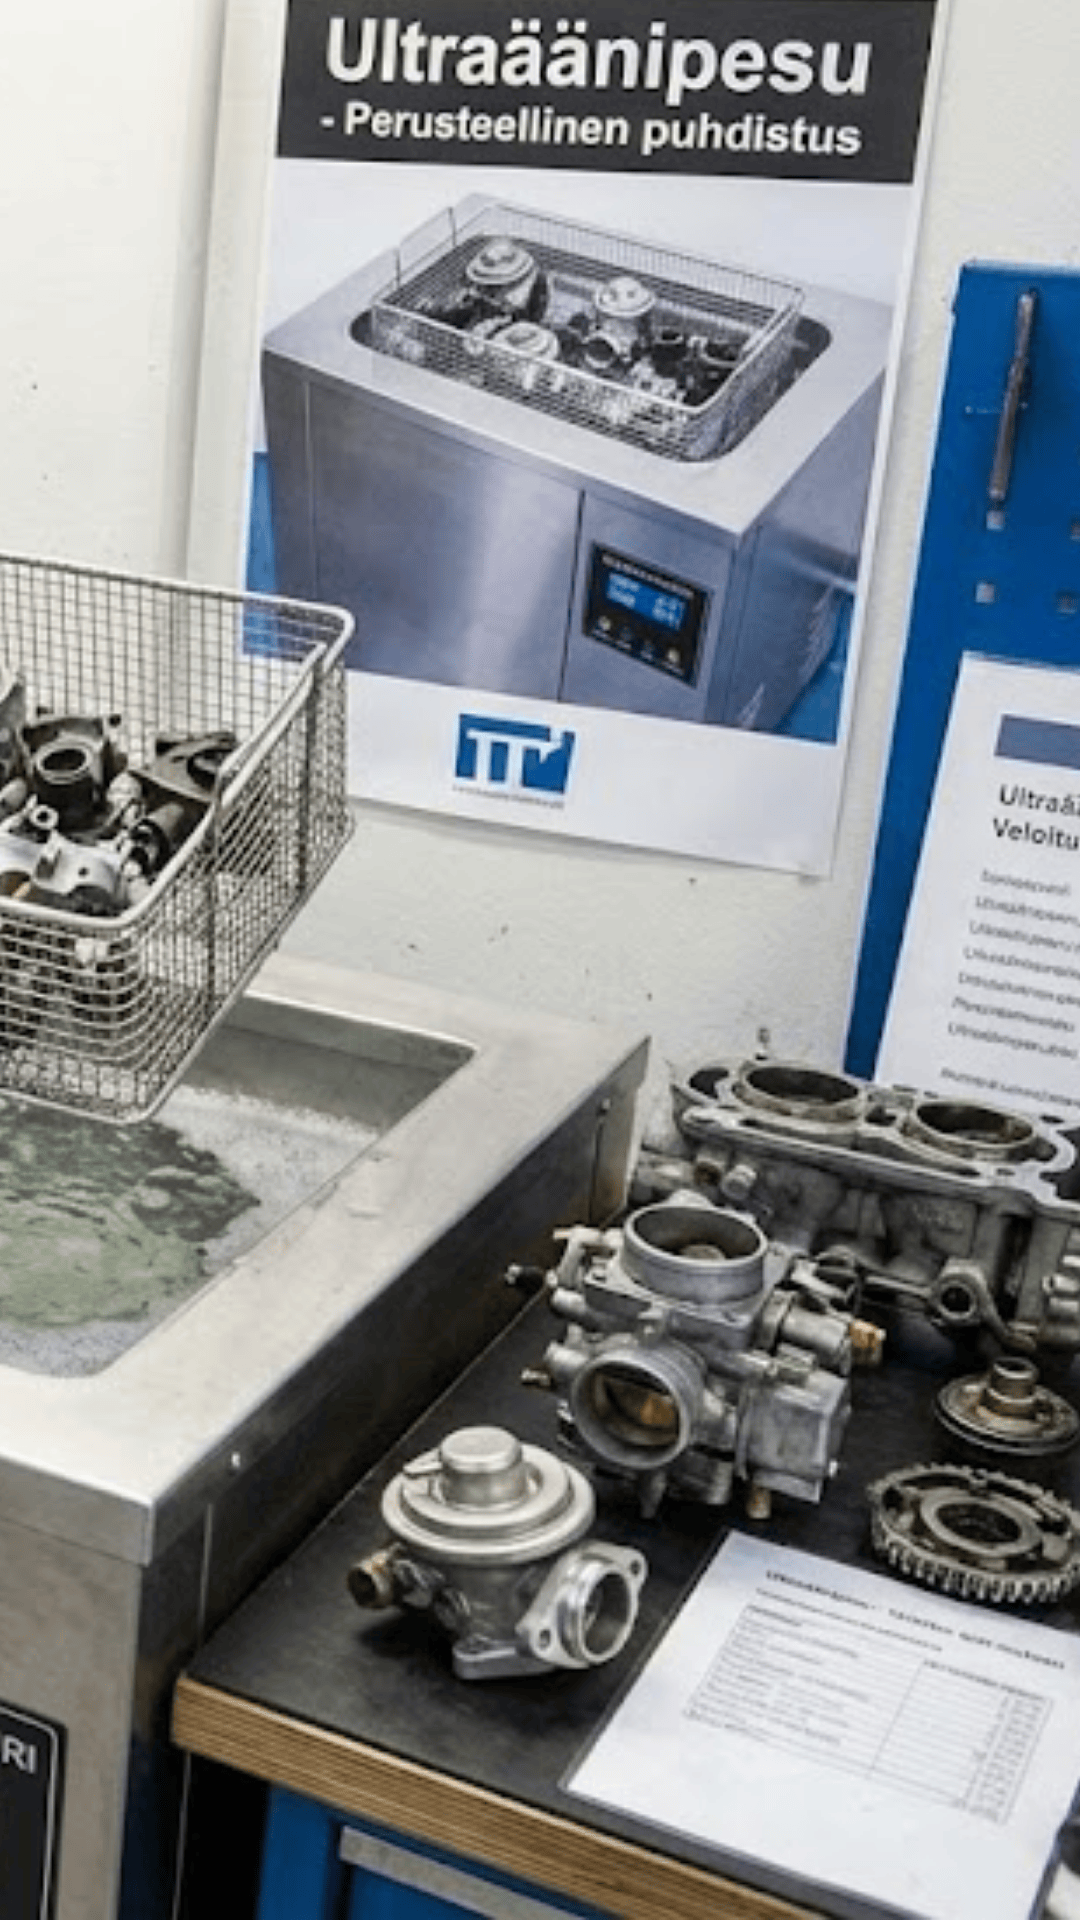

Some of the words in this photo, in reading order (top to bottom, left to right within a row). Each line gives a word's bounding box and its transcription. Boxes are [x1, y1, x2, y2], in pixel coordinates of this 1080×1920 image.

[326, 17, 872, 106] Ultraäänipesu
[345, 100, 629, 145] Perusteellinen
[642, 117, 861, 155] puhdistus
[1, 1734, 38, 1775] RI
